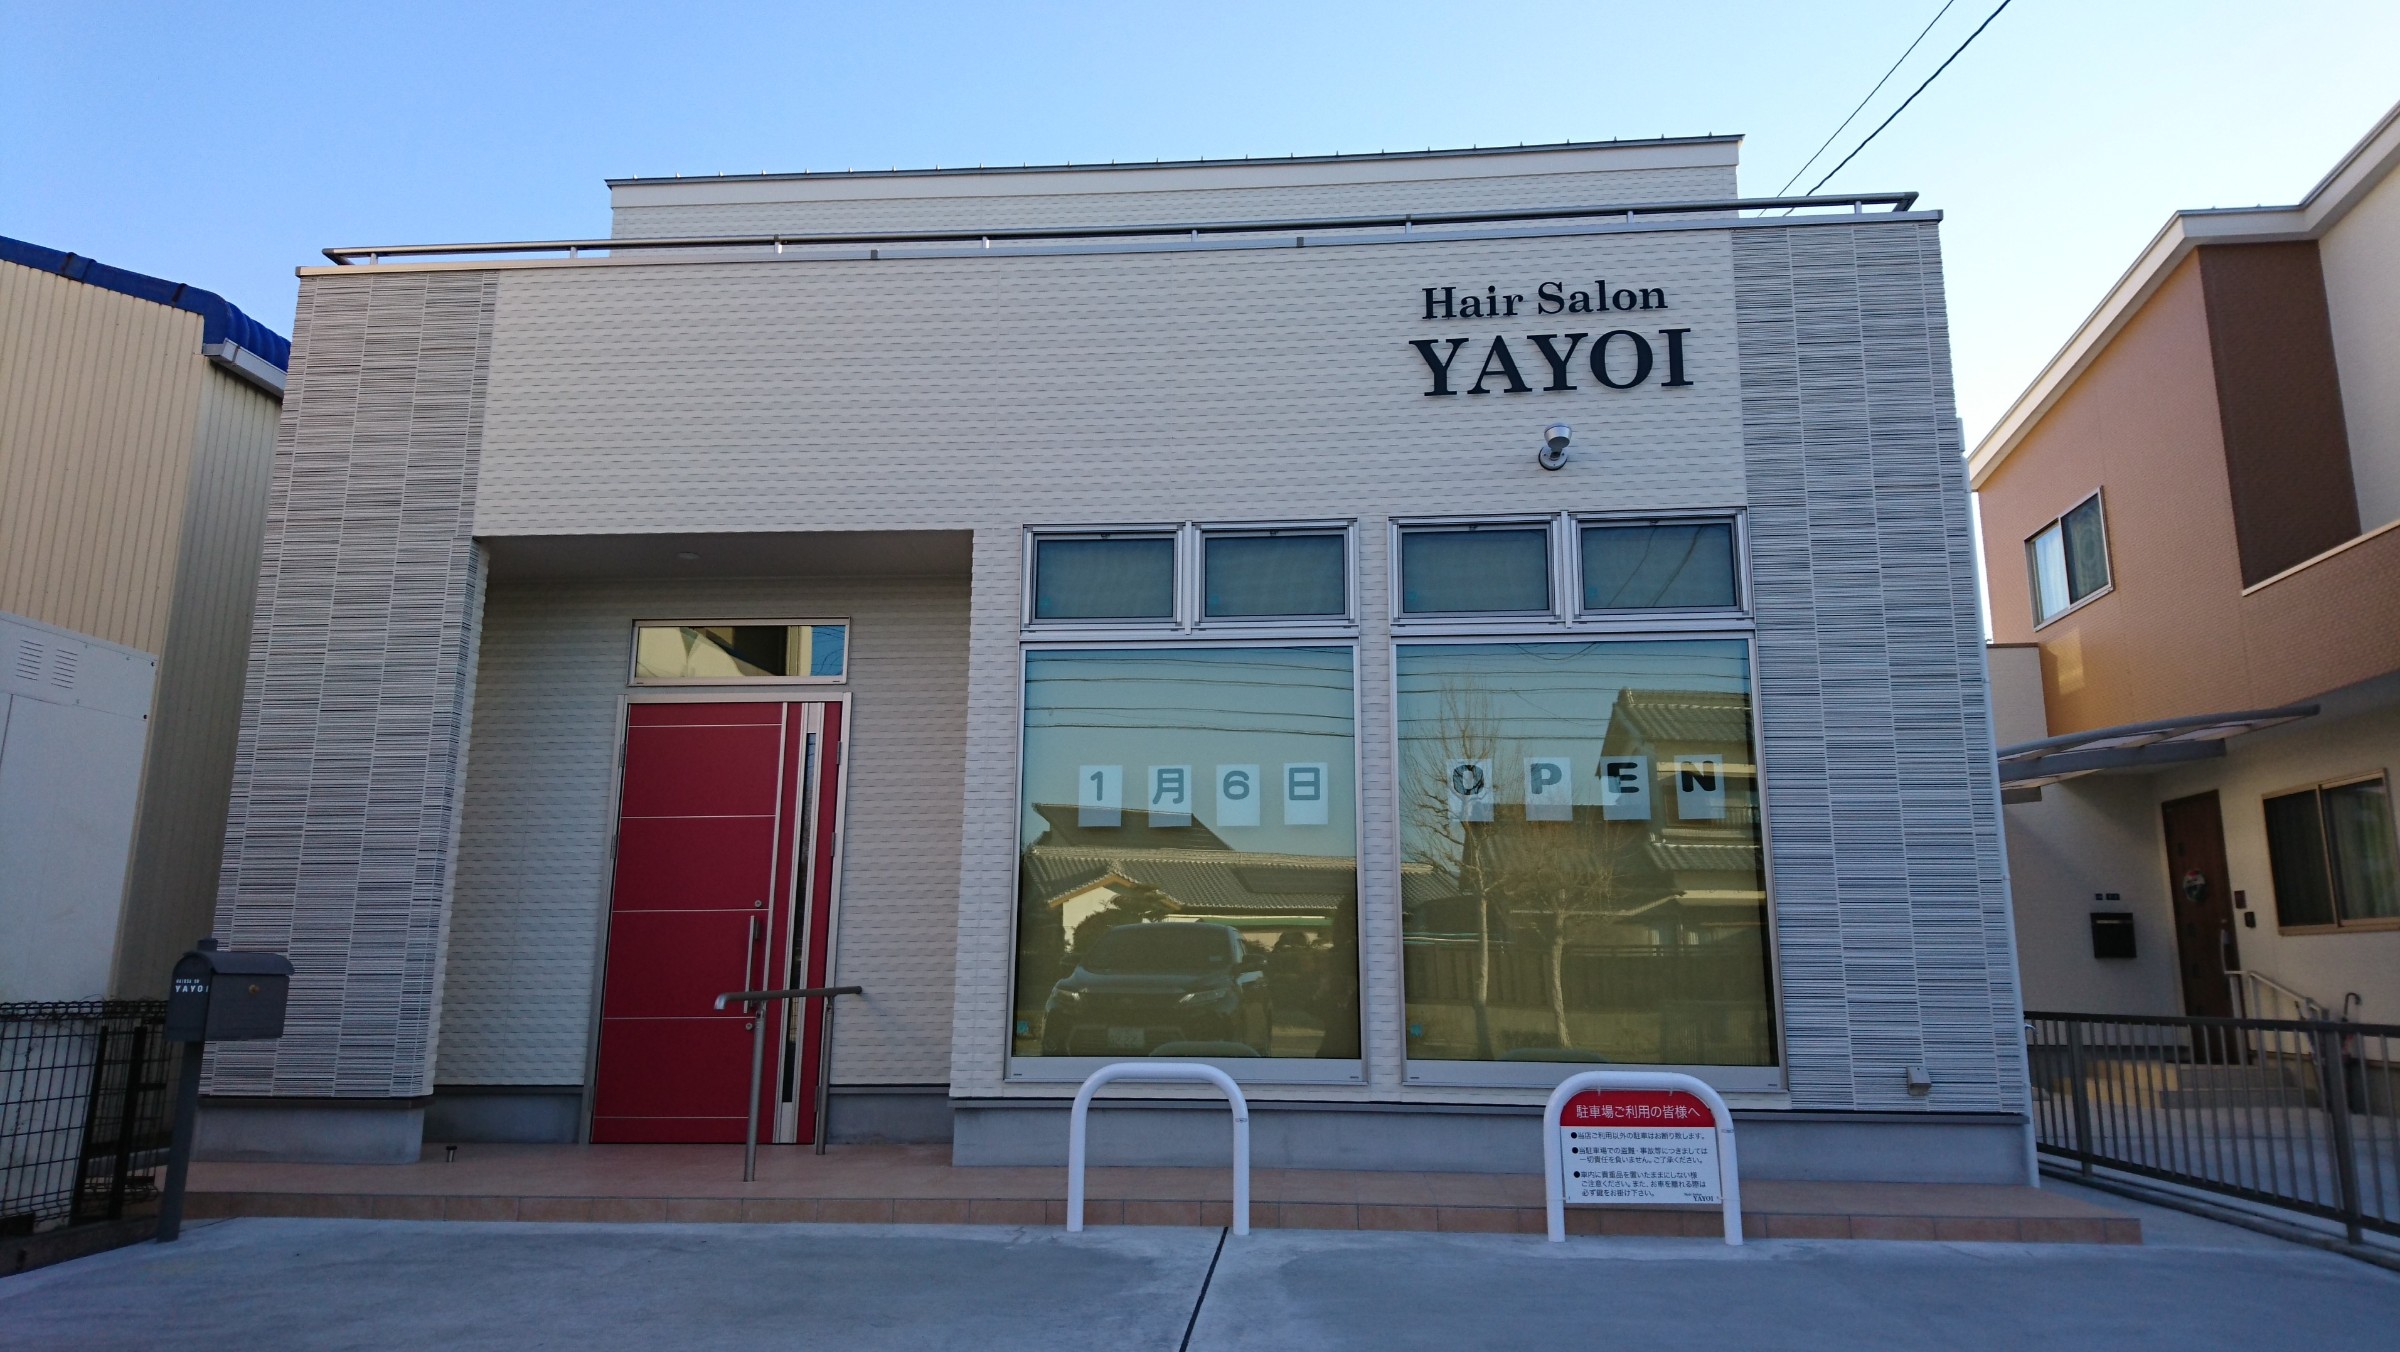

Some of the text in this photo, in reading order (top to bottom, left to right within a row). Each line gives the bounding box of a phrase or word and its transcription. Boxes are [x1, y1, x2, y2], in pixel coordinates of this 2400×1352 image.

[1421, 279, 1669, 320] Hair Salon
[1408, 327, 1694, 397] YAYOI
[1090, 767, 1320, 804] 1月6日
[1452, 760, 1716, 795] OPEN
[175, 985, 209, 993] YAYOI
[1576, 1104, 1700, 1119] 駐車場ご利用の皆様へ
